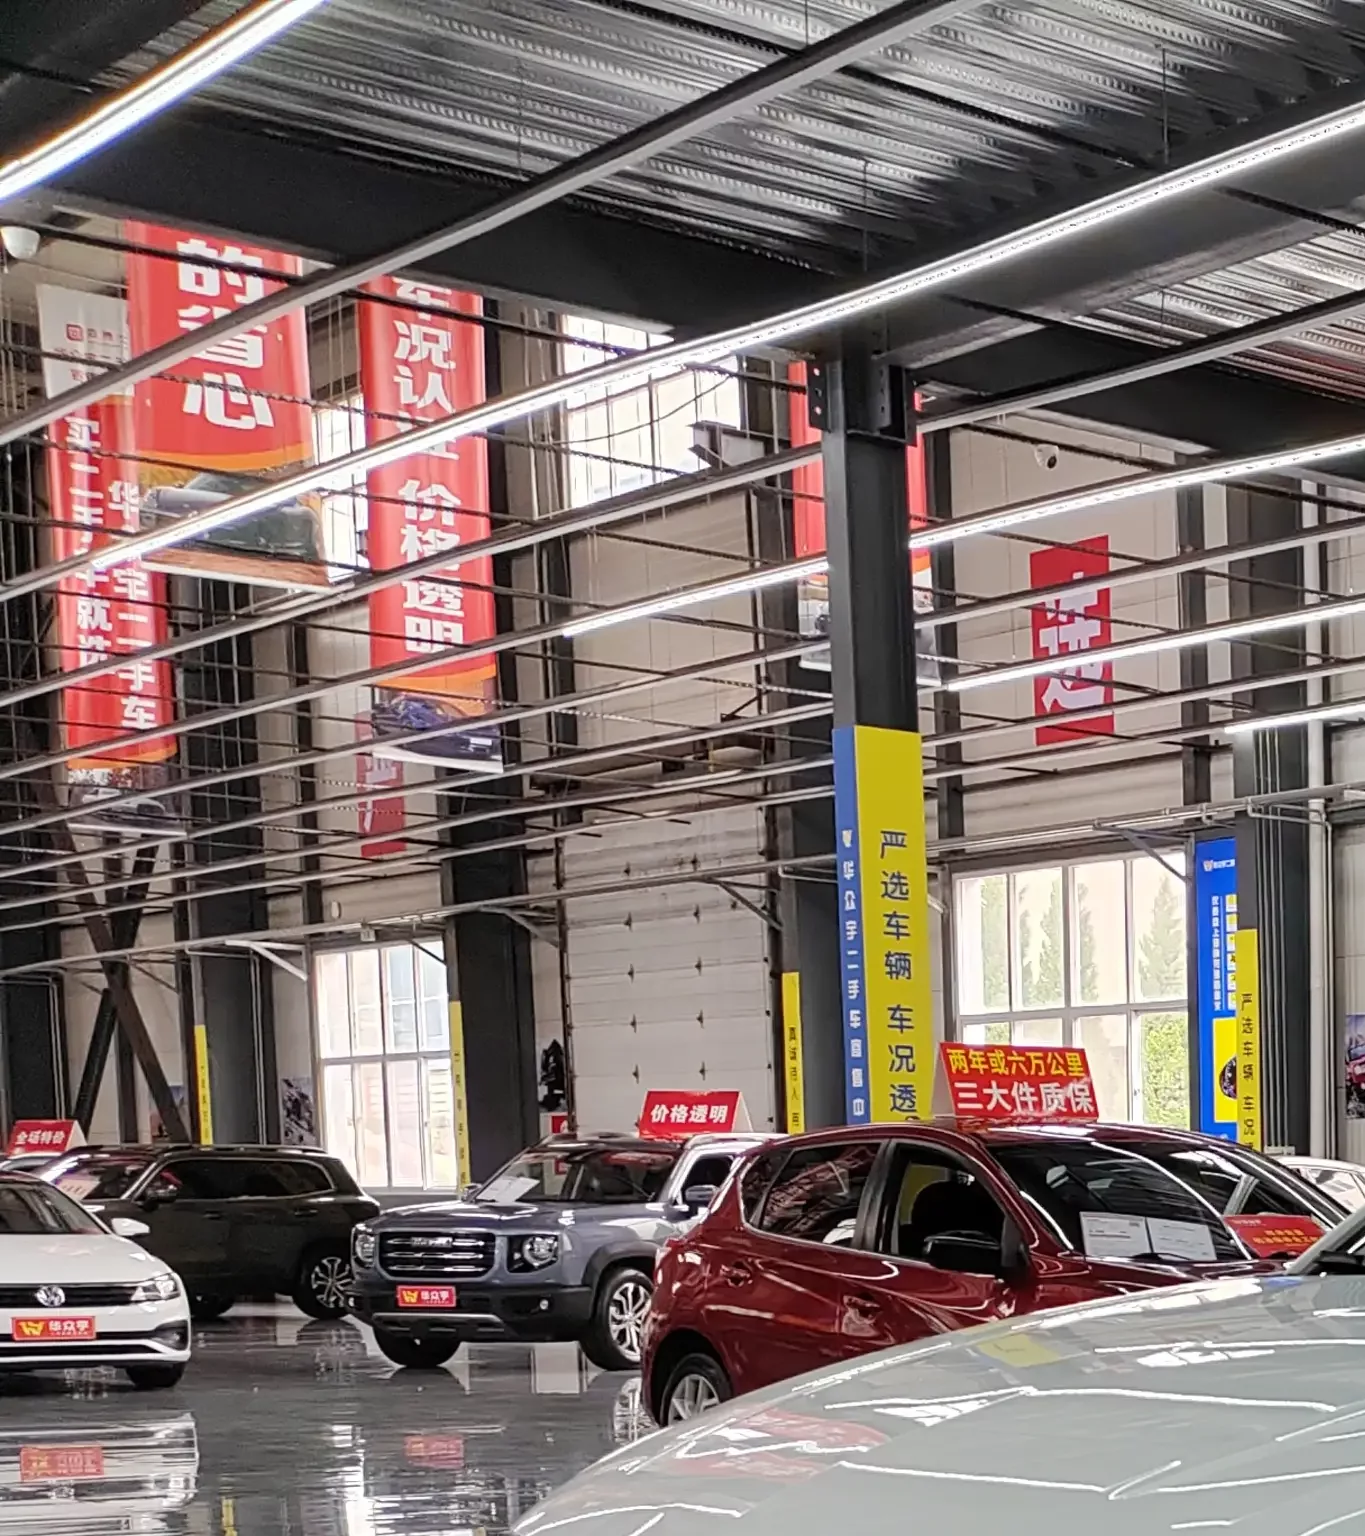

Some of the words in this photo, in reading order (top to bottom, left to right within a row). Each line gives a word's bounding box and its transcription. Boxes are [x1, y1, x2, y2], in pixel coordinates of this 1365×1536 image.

[879, 829, 913, 981] 严选车辆
[946, 1047, 1086, 1077] 两年或六万公里
[953, 1080, 1095, 1114] 三大件质保
[650, 1103, 729, 1124] 价格透明
